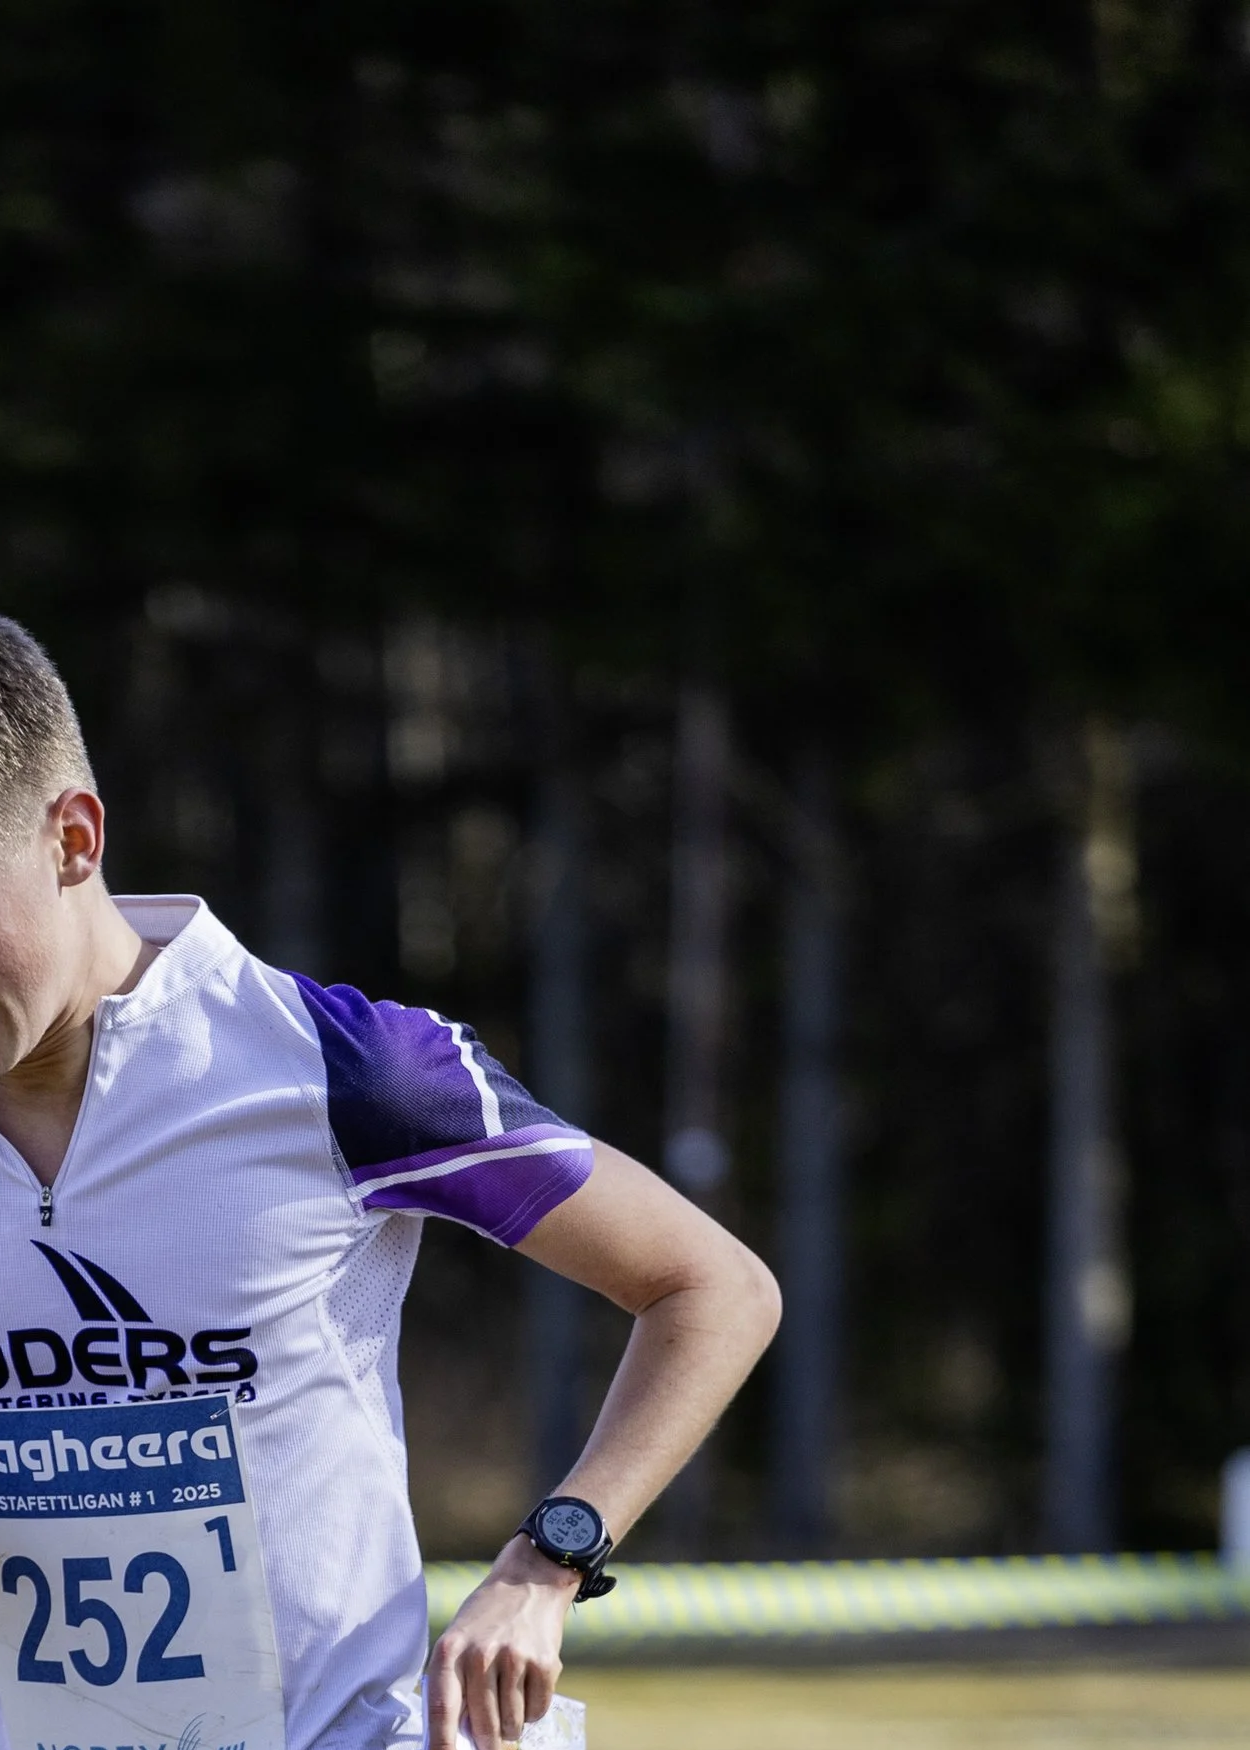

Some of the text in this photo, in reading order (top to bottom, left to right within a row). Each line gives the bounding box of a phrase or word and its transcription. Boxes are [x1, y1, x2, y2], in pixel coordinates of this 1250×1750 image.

[172, 1483, 222, 1503] 2025
[204, 1515, 237, 1572] 1
[1, 1551, 205, 1687] 252
